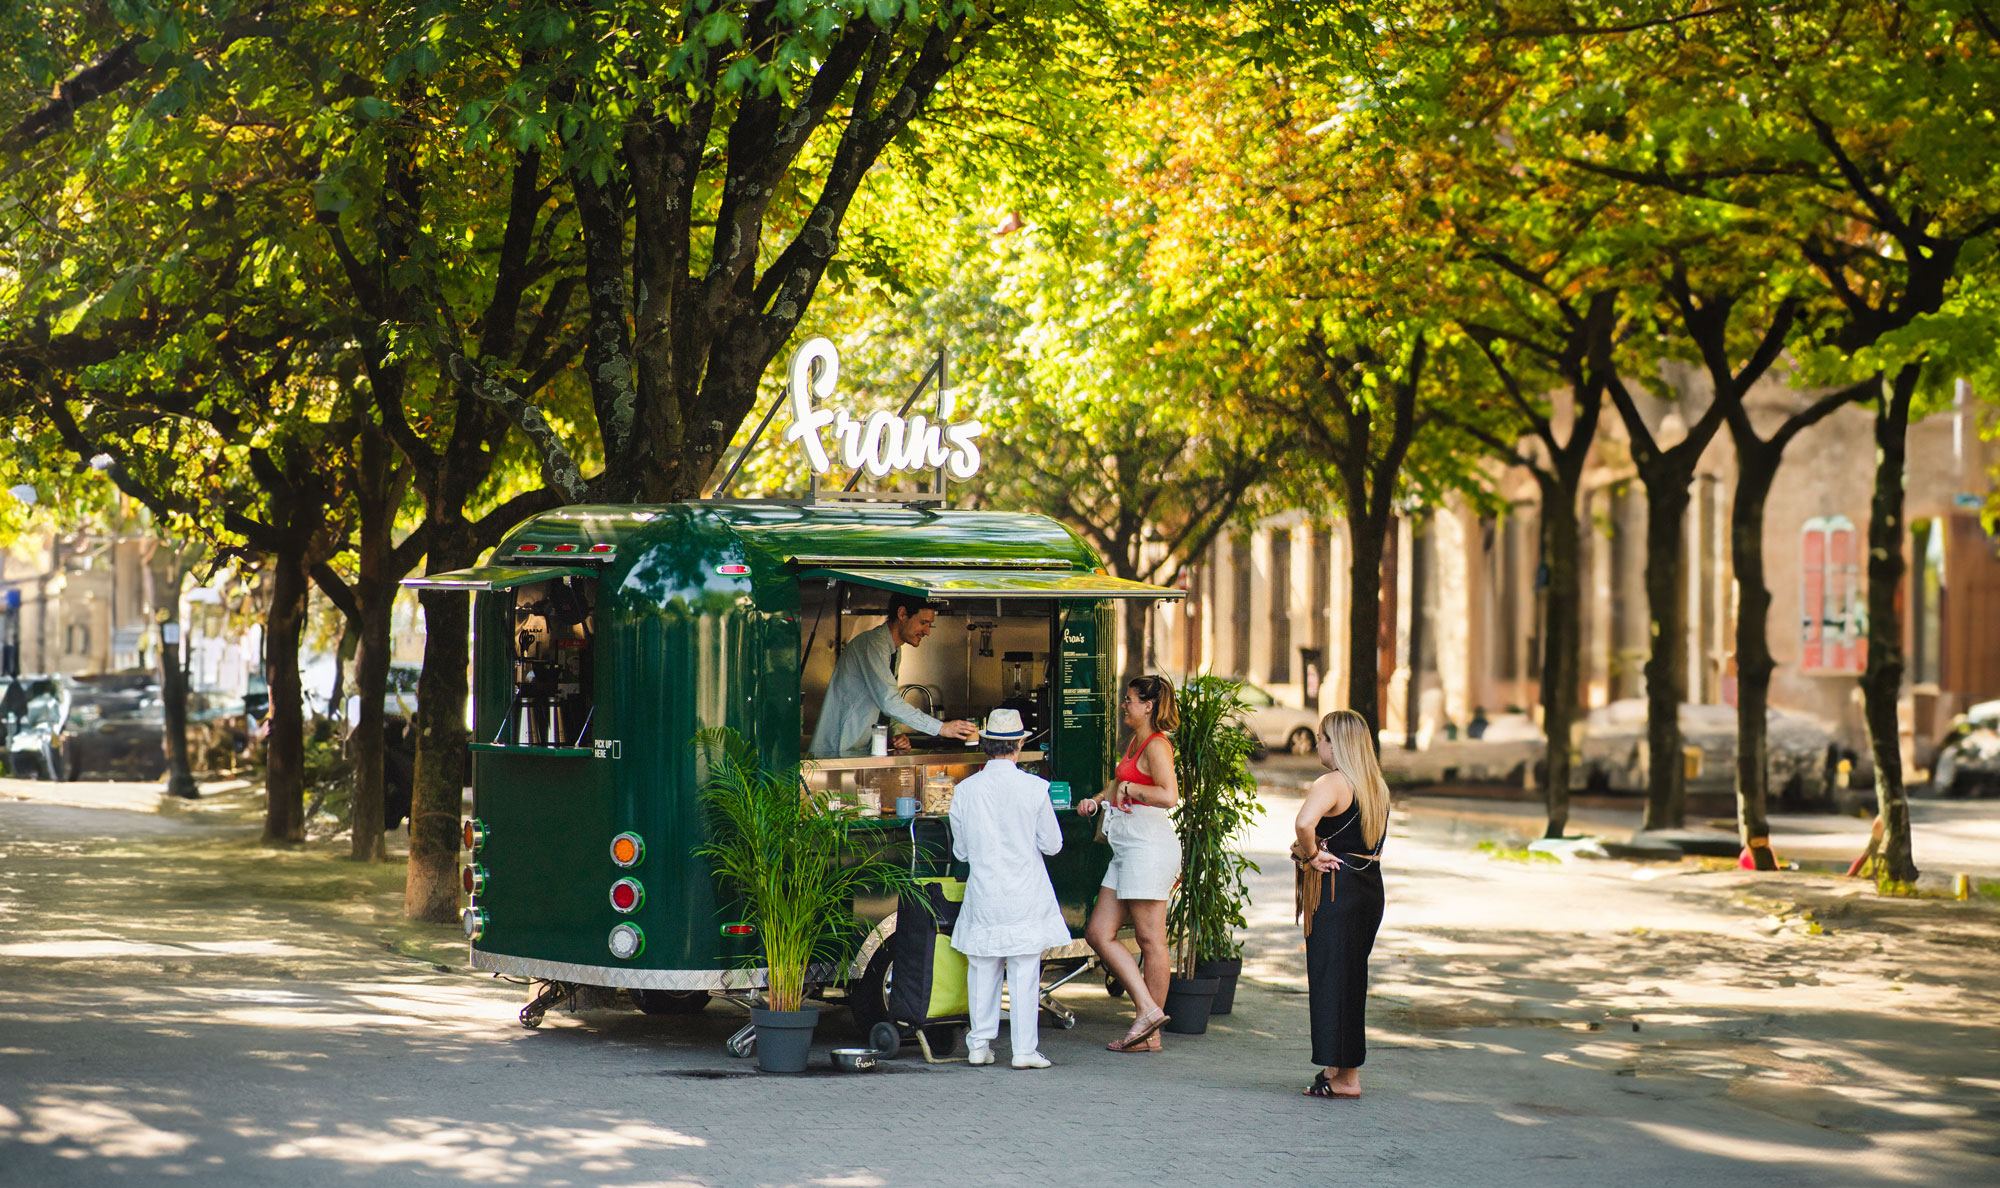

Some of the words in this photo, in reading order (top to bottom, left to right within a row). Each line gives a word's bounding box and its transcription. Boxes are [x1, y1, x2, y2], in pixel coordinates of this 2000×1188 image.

[784, 336, 983, 480] fran's
[1064, 628, 1085, 643] fran's
[595, 739, 605, 748] PICK
[605, 739, 612, 749] UP
[595, 749, 606, 758] HERE
[855, 1056, 876, 1068] fran's
